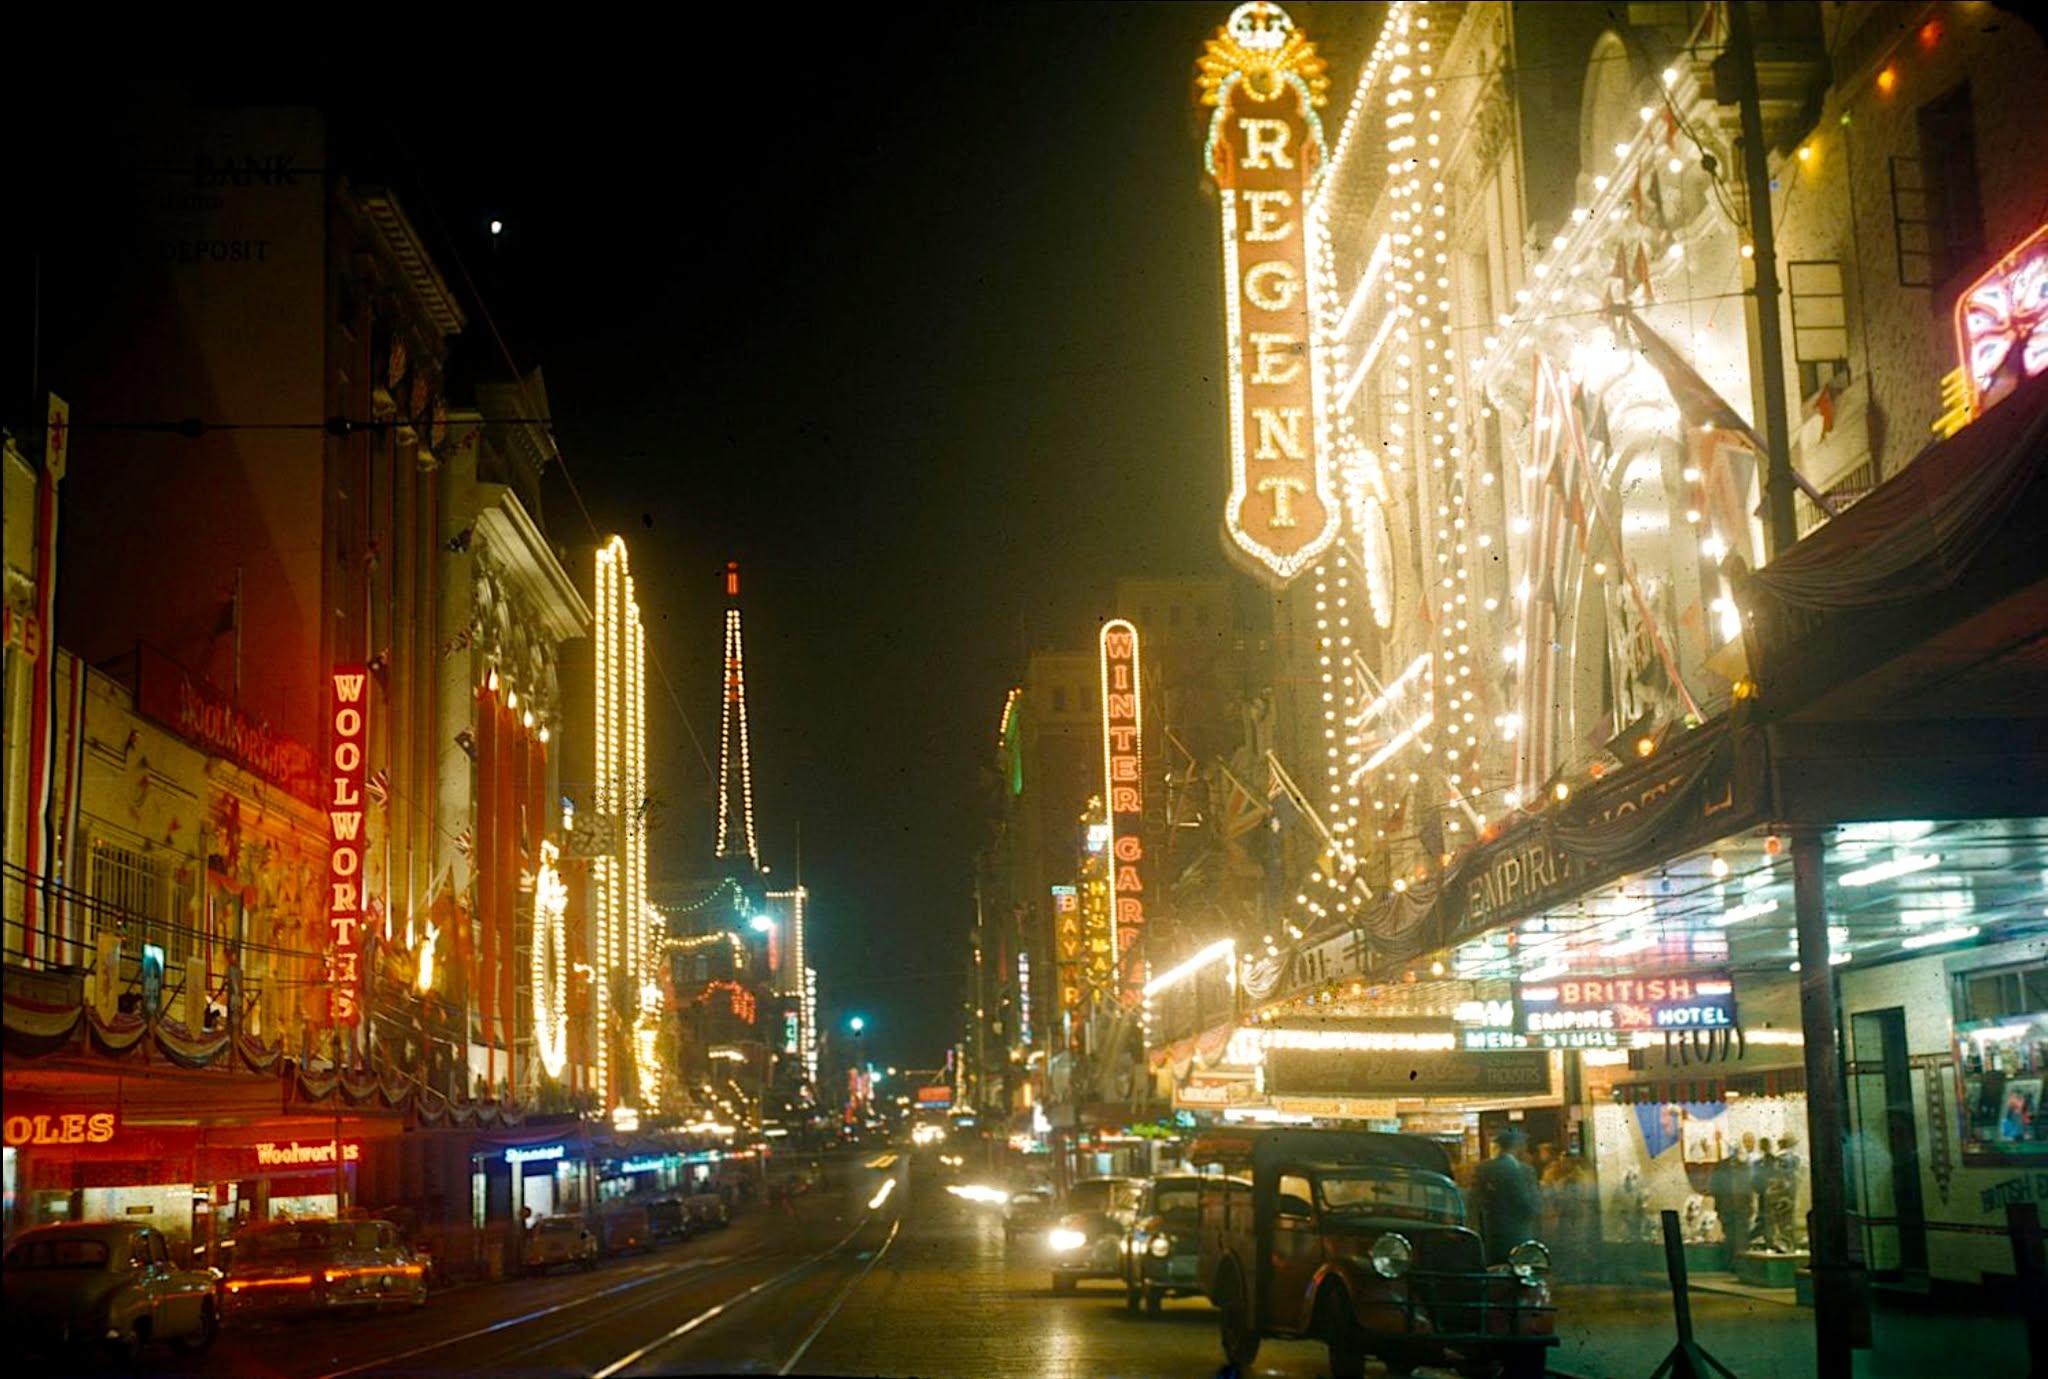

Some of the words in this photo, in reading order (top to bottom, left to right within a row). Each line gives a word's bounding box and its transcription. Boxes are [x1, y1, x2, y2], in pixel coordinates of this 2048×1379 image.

[193, 152, 298, 187] BANK
[158, 240, 271, 263] DEPOSIT
[1238, 117, 1307, 528] REGENT
[1106, 632, 1142, 813] WINTER
[326, 674, 366, 1018] WOOLWORTHS
[1561, 981, 1692, 1003] BRITISH
[1527, 1009, 1614, 1031] EMPIRE
[1657, 1006, 1730, 1026] HOTEL
[3, 1113, 115, 1145] OLES
